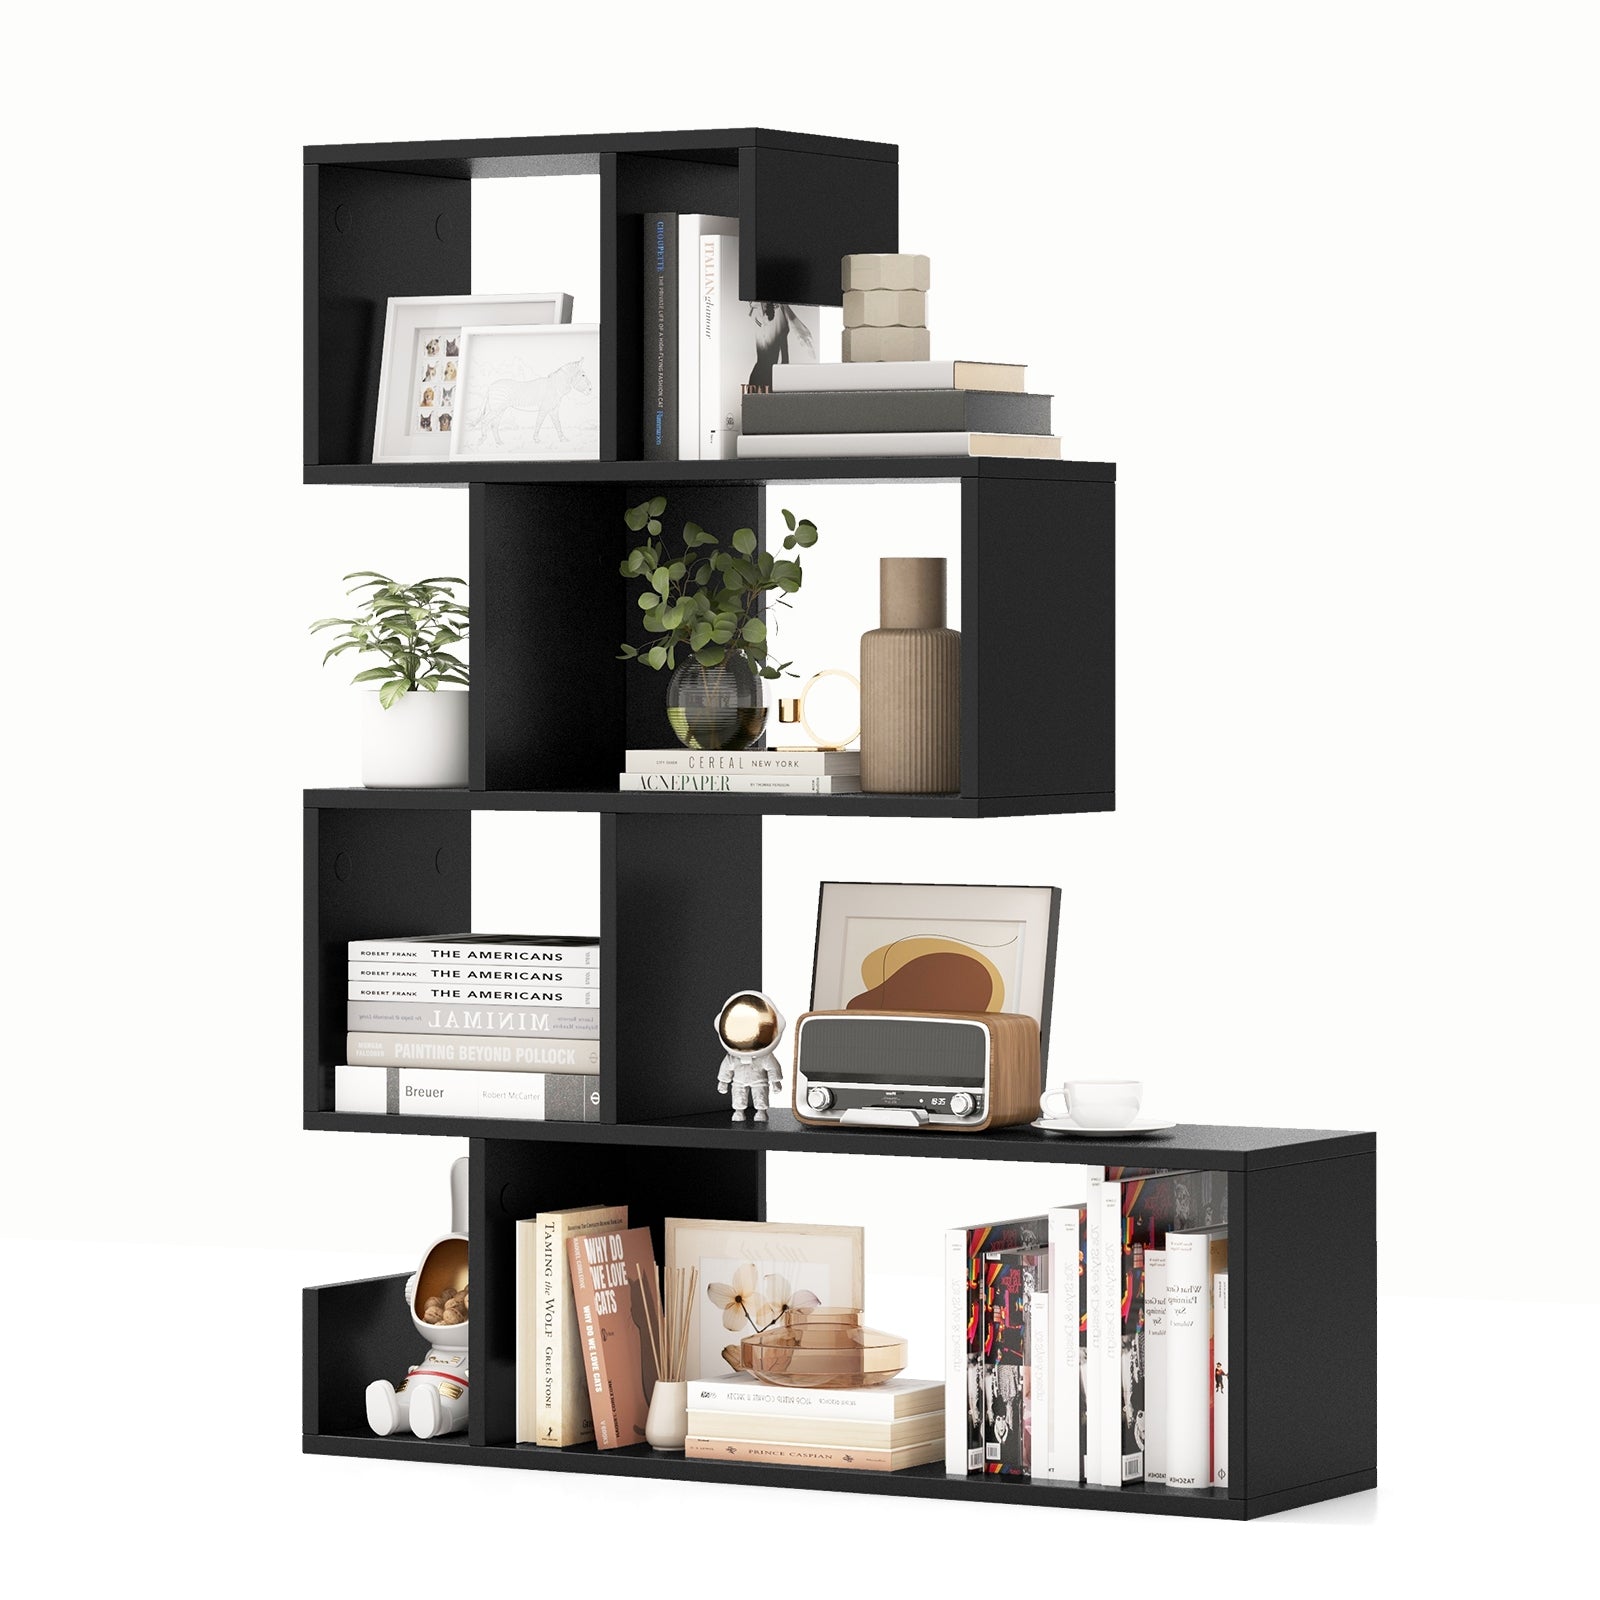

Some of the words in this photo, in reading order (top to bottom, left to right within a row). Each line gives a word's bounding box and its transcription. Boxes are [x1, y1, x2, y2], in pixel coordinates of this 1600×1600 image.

[688, 756, 744, 769] CEREAL
[751, 759, 774, 768] NEW
[776, 760, 800, 768] YORK
[431, 950, 460, 958] THE
[468, 951, 563, 961] AMERICANS
[431, 969, 460, 978] THE
[468, 971, 563, 981] AMERICANS
[431, 989, 460, 998] THE
[468, 990, 563, 1001] AMERICANS
[394, 1043, 454, 1060] PAINTING
[459, 1045, 512, 1062] BEYOND
[516, 1047, 576, 1064] POLLOCK
[405, 1086, 444, 1098] Breuer
[482, 1091, 506, 1100] Robert
[508, 1092, 540, 1101] McCarter
[544, 1222, 555, 1277] TAMING
[584, 1236, 610, 1264] WHY
[609, 1234, 624, 1260] DO
[590, 1266, 608, 1289] WE
[608, 1264, 629, 1286] LOVE
[544, 1281, 552, 1296] the
[594, 1290, 618, 1316] CATS
[545, 1299, 557, 1338] WOLF
[582, 1306, 590, 1324] WHY
[586, 1325, 594, 1336] DO
[588, 1338, 596, 1350] WE
[545, 1346, 553, 1374] GREG
[590, 1352, 599, 1372] LOVE
[593, 1372, 602, 1392] CATS
[544, 1376, 553, 1408] STONE
[748, 1449, 784, 1458] PRINCE
[789, 1452, 833, 1460] CASPIAN
